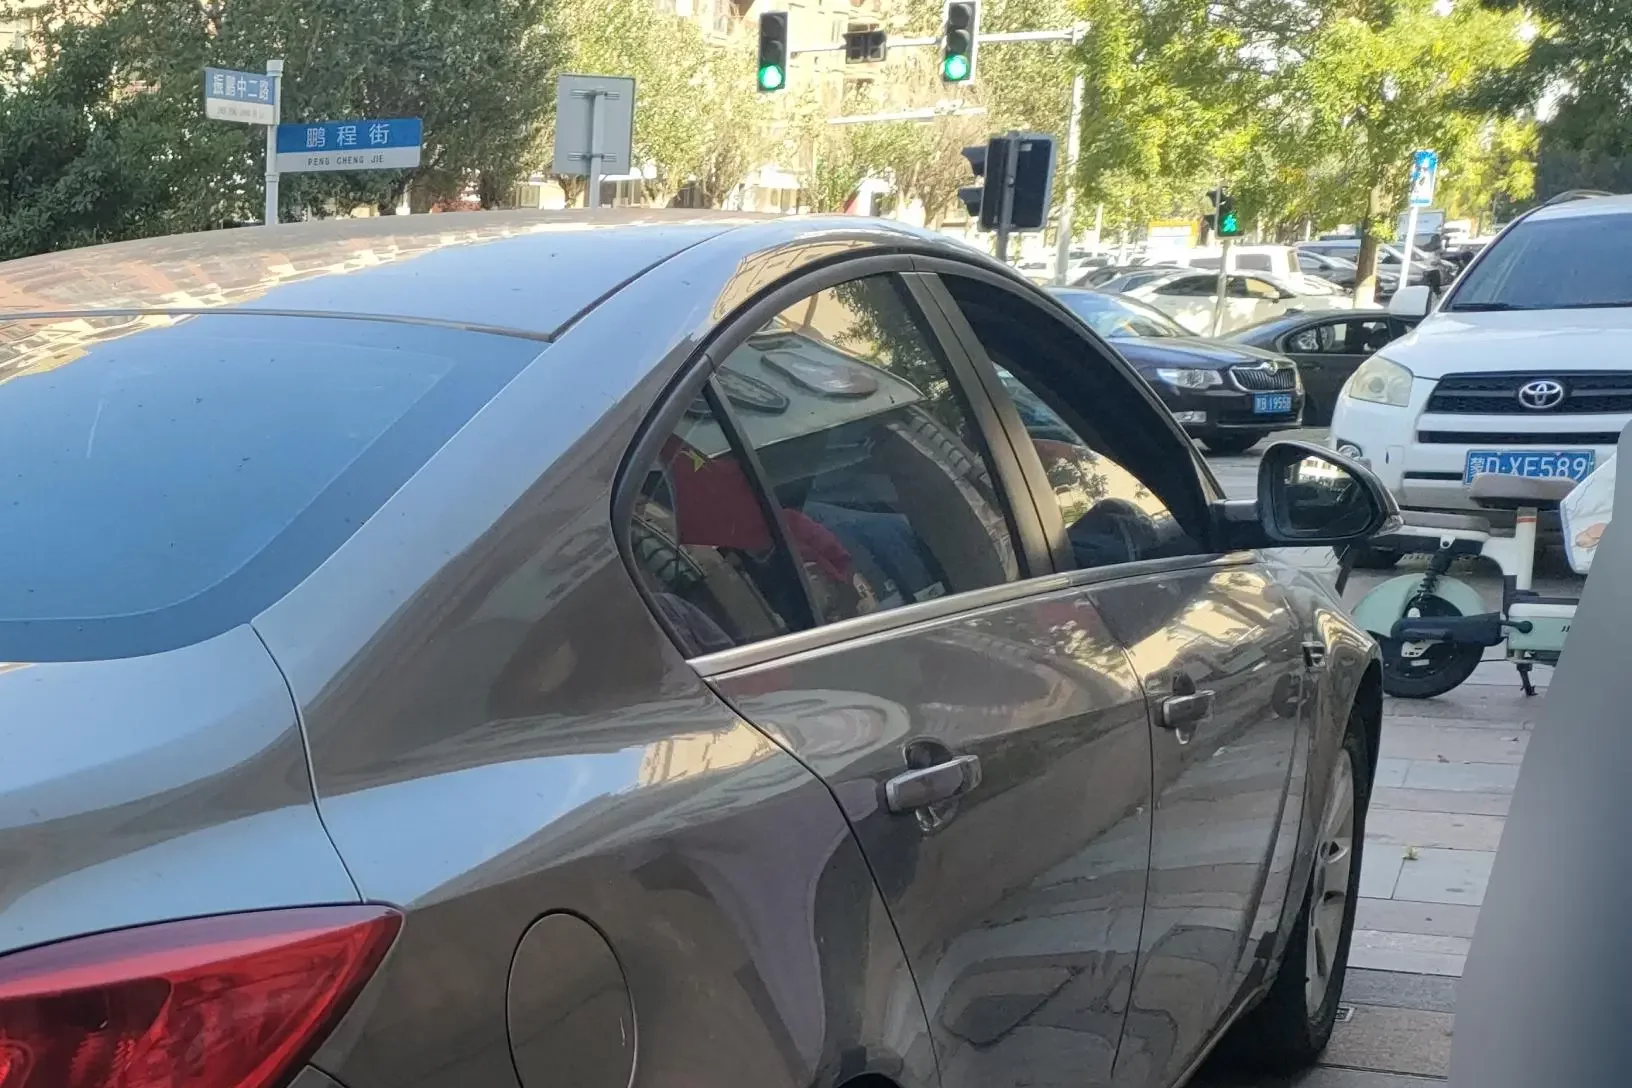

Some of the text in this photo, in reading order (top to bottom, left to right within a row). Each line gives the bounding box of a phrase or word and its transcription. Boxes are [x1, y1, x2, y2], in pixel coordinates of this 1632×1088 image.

[306, 123, 390, 148] 鹏程街
[307, 154, 385, 166] PENG CHENG JIE
